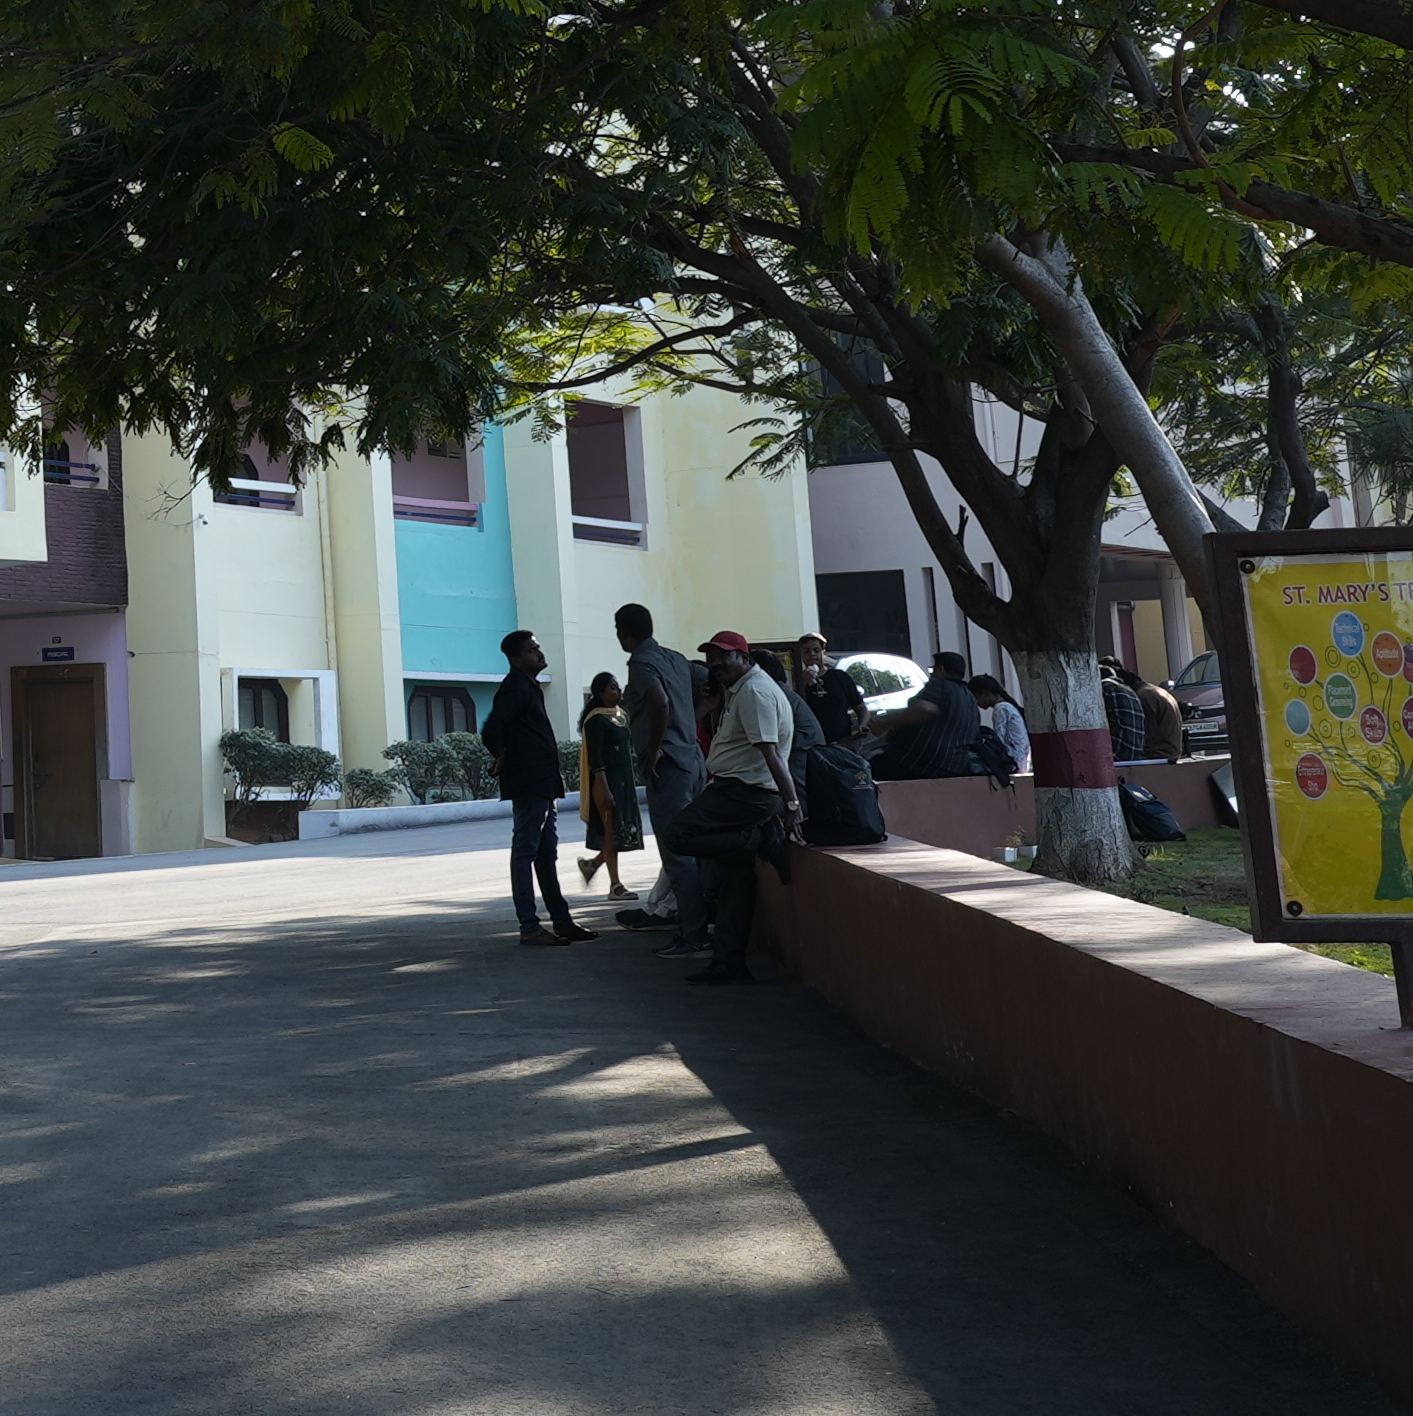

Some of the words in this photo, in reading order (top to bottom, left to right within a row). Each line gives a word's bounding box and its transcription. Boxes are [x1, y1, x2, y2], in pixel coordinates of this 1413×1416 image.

[1281, 585, 1311, 605] ST.
[1318, 582, 1390, 604] MARY'S
[1376, 647, 1399, 661] Aptitude
